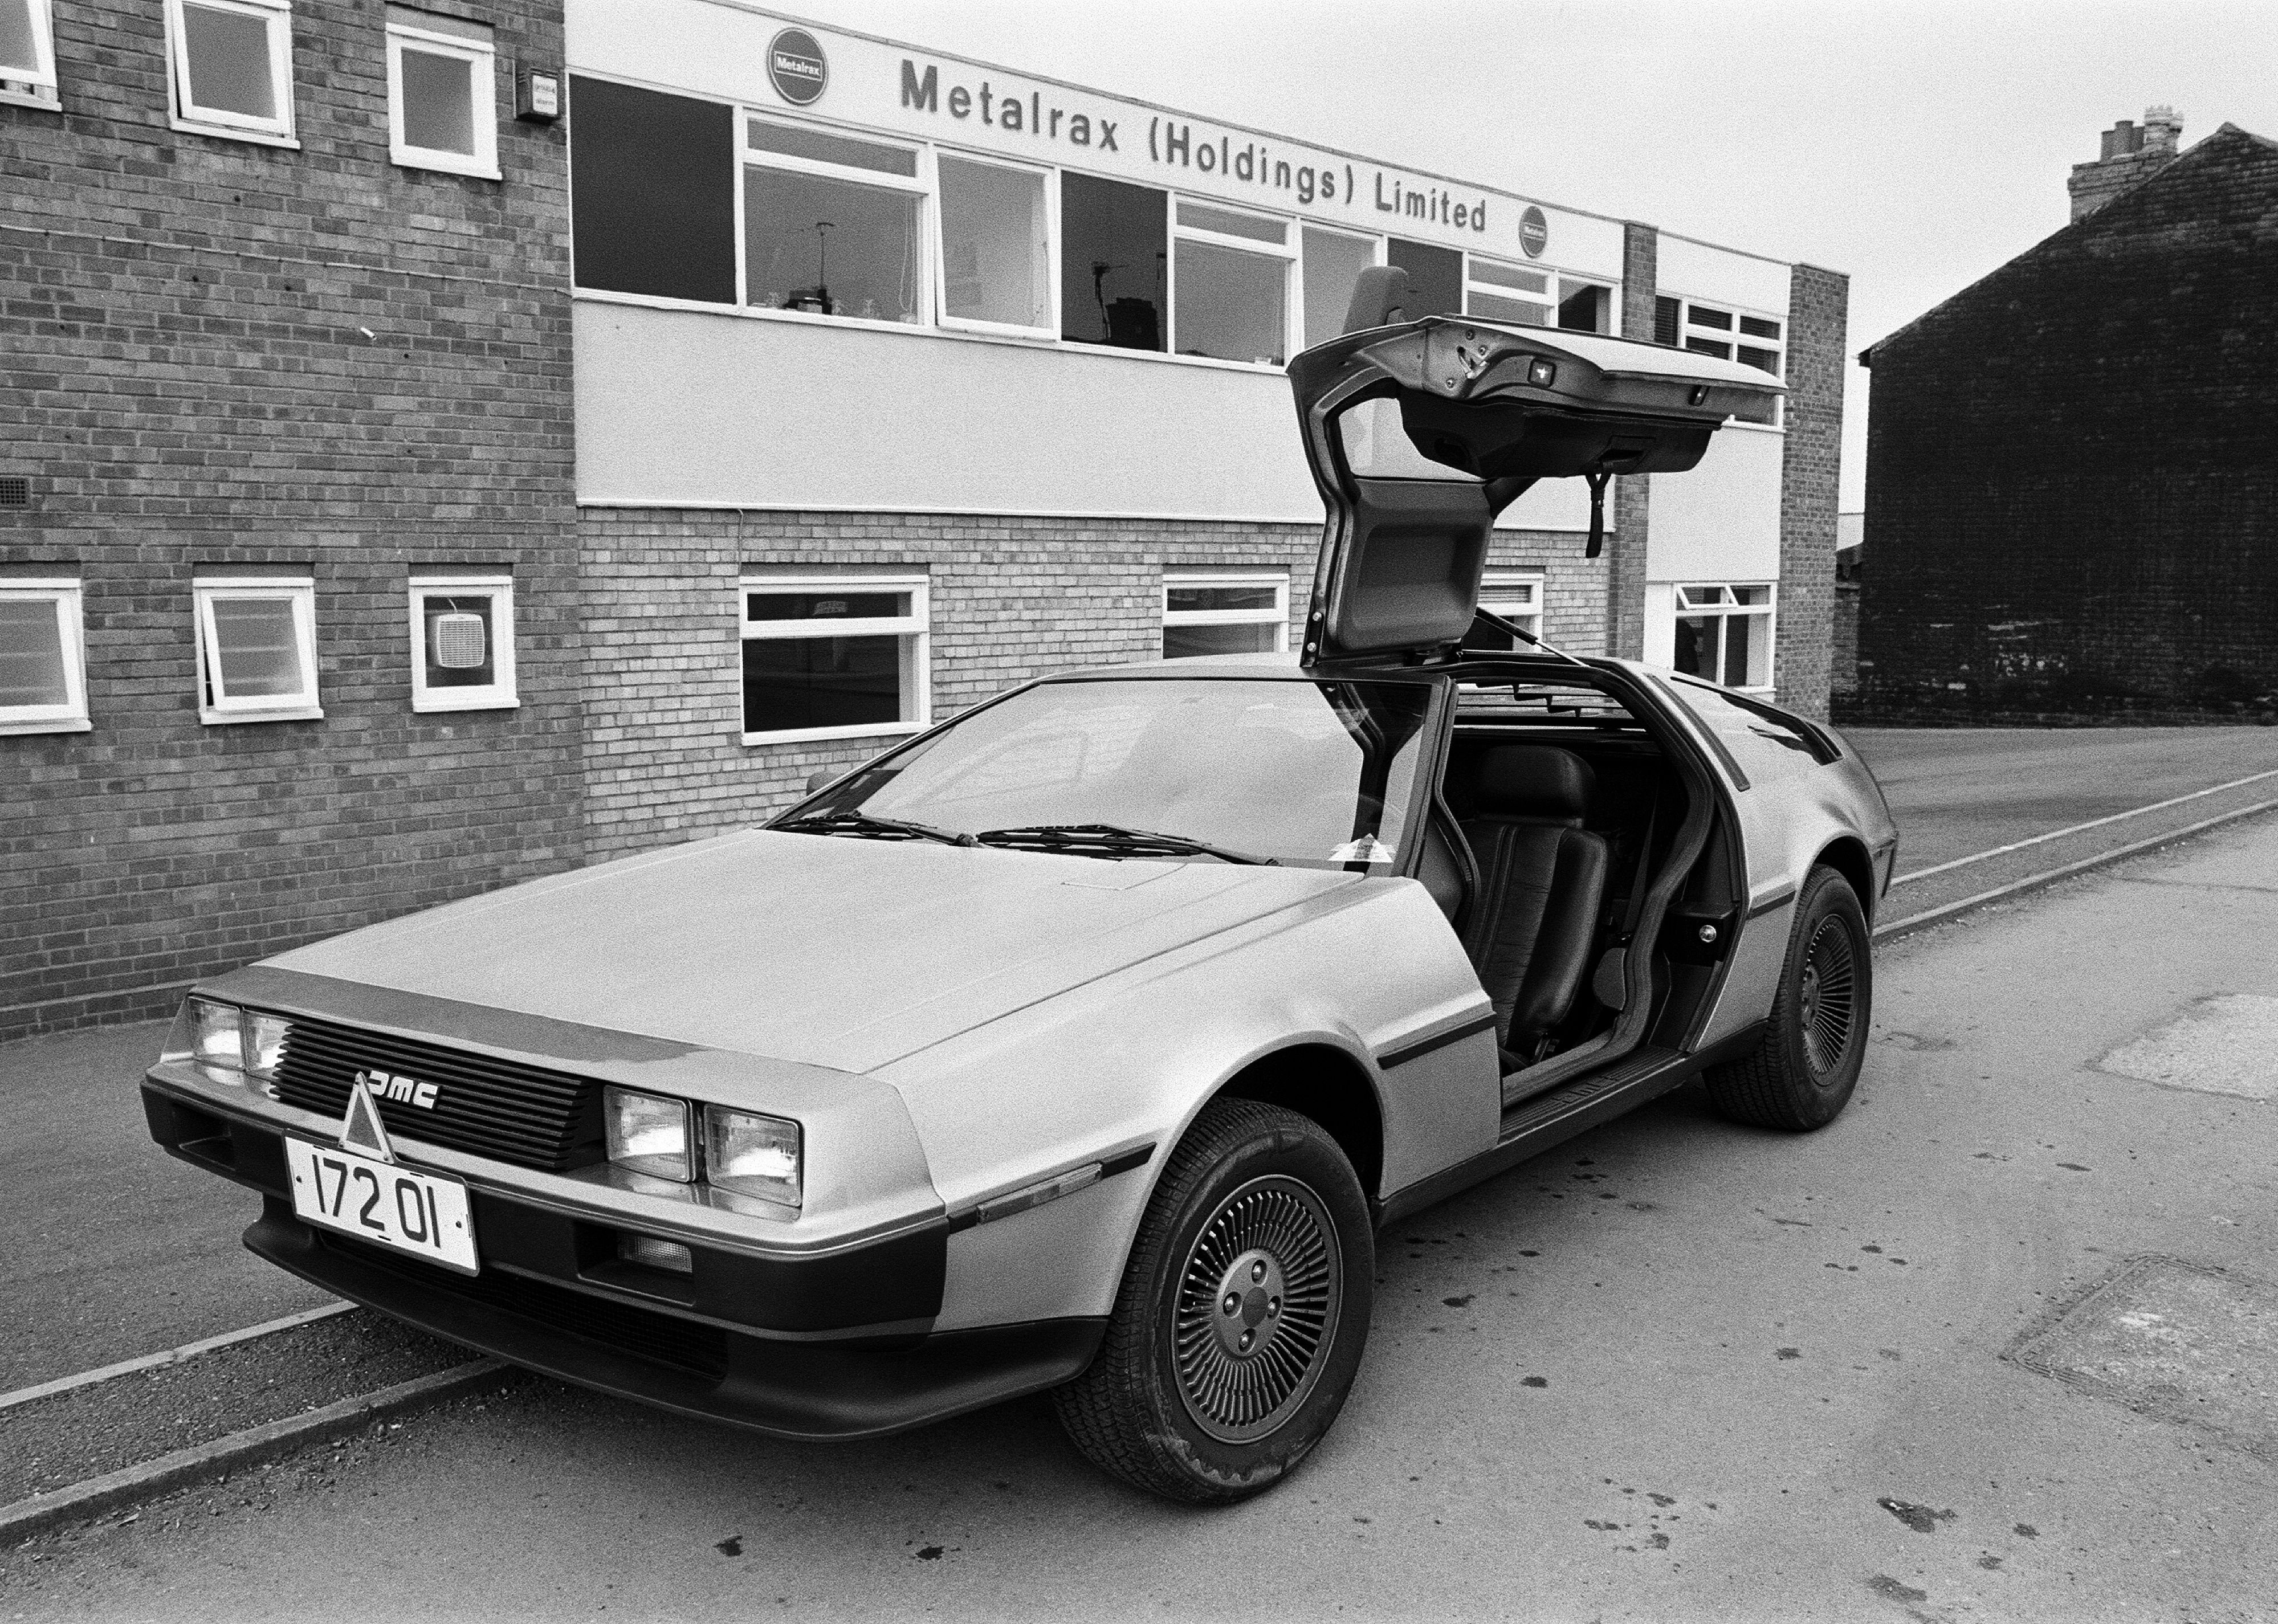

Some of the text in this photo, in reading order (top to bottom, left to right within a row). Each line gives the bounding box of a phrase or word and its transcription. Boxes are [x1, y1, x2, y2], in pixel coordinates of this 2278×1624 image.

[777, 56, 820, 75] Metalrax
[900, 59, 1486, 232] Metalrax (Holdings) Limited
[368, 1070, 439, 1109] DMC
[311, 1154, 441, 1248] 172 01
